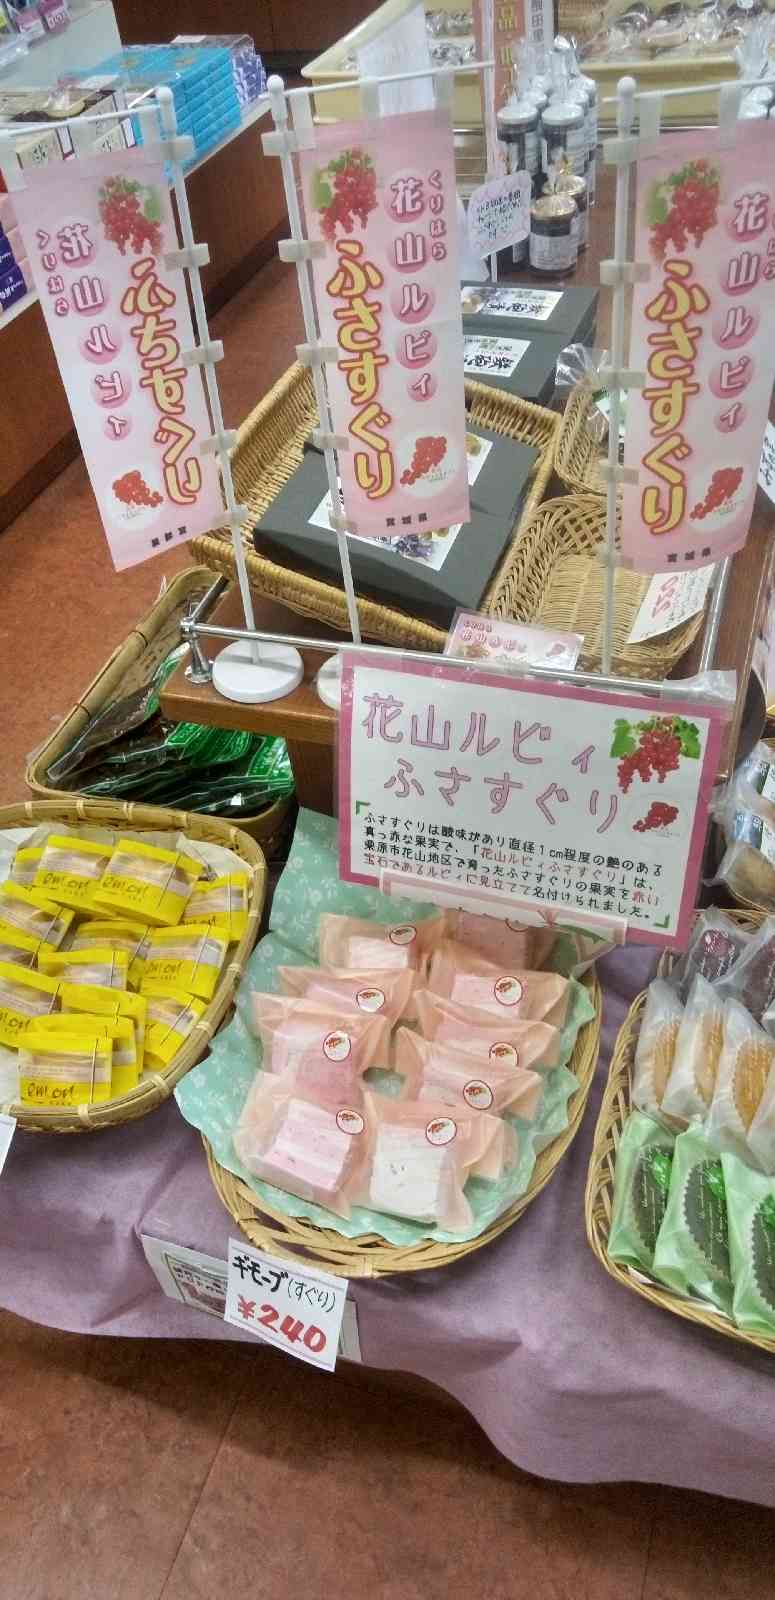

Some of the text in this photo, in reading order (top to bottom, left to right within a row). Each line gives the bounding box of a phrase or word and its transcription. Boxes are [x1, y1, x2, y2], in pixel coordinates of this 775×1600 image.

[390, 178, 432, 402] 花山ルビィ
[428, 170, 447, 260] くりはら
[326, 240, 395, 500] ふさすぐり
[718, 191, 769, 430] 花山ルビィ
[642, 260, 711, 534] ふさすぐり
[361, 692, 597, 774] 花山ルビィ
[383, 758, 618, 834] ふさすぐり
[236, 1293, 328, 1354] ¥240
